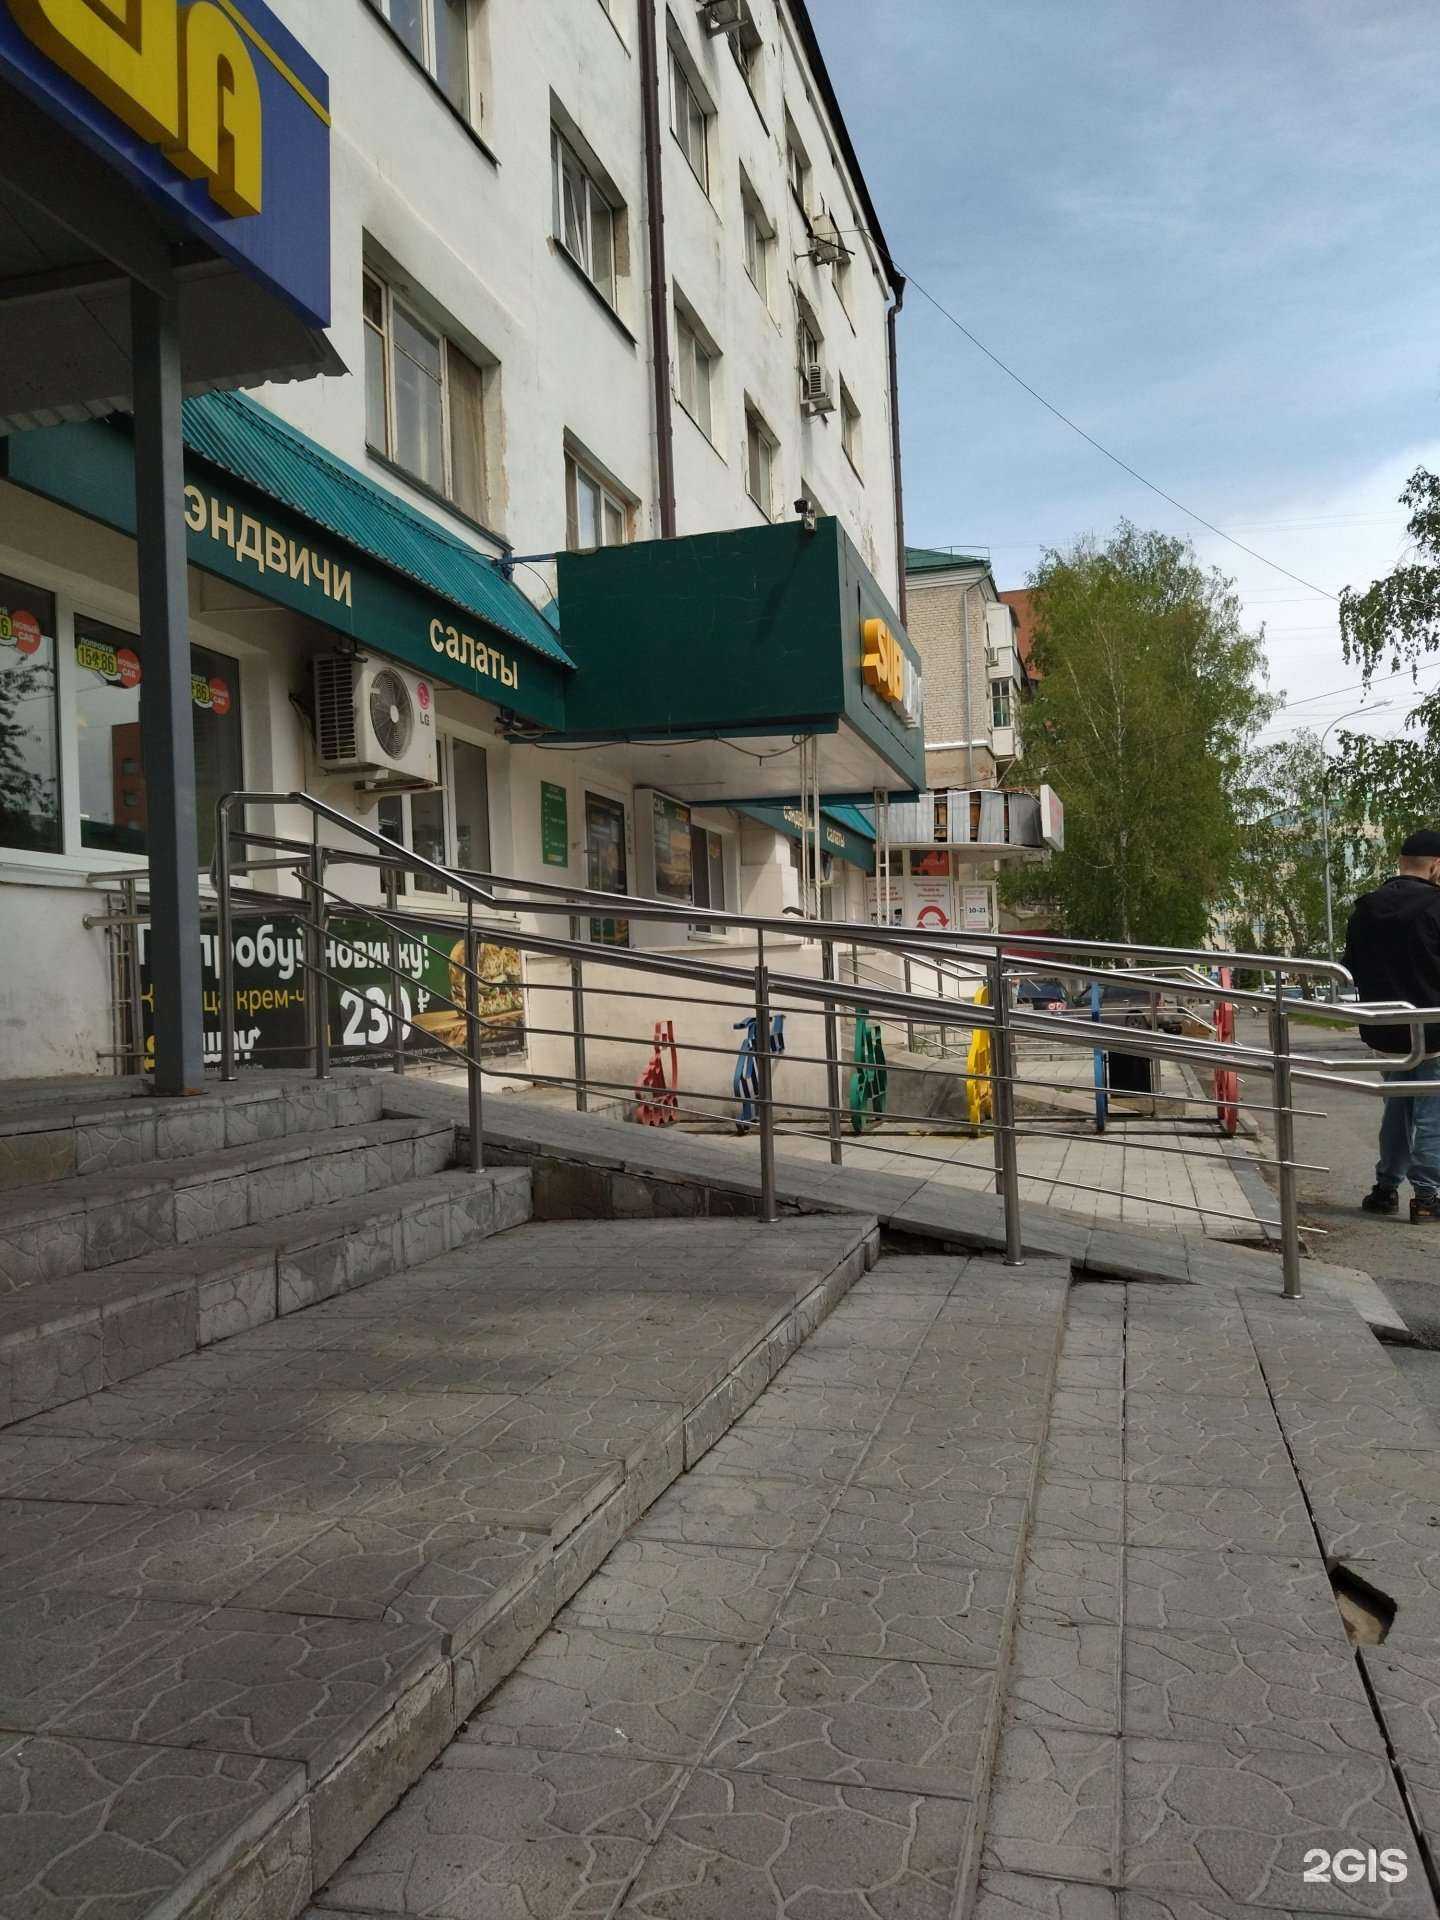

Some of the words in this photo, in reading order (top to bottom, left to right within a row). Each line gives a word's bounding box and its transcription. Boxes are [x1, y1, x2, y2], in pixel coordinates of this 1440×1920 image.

[184, 484, 352, 608] эндвичи
[430, 618, 518, 690] салаты
[420, 711, 430, 726] LG
